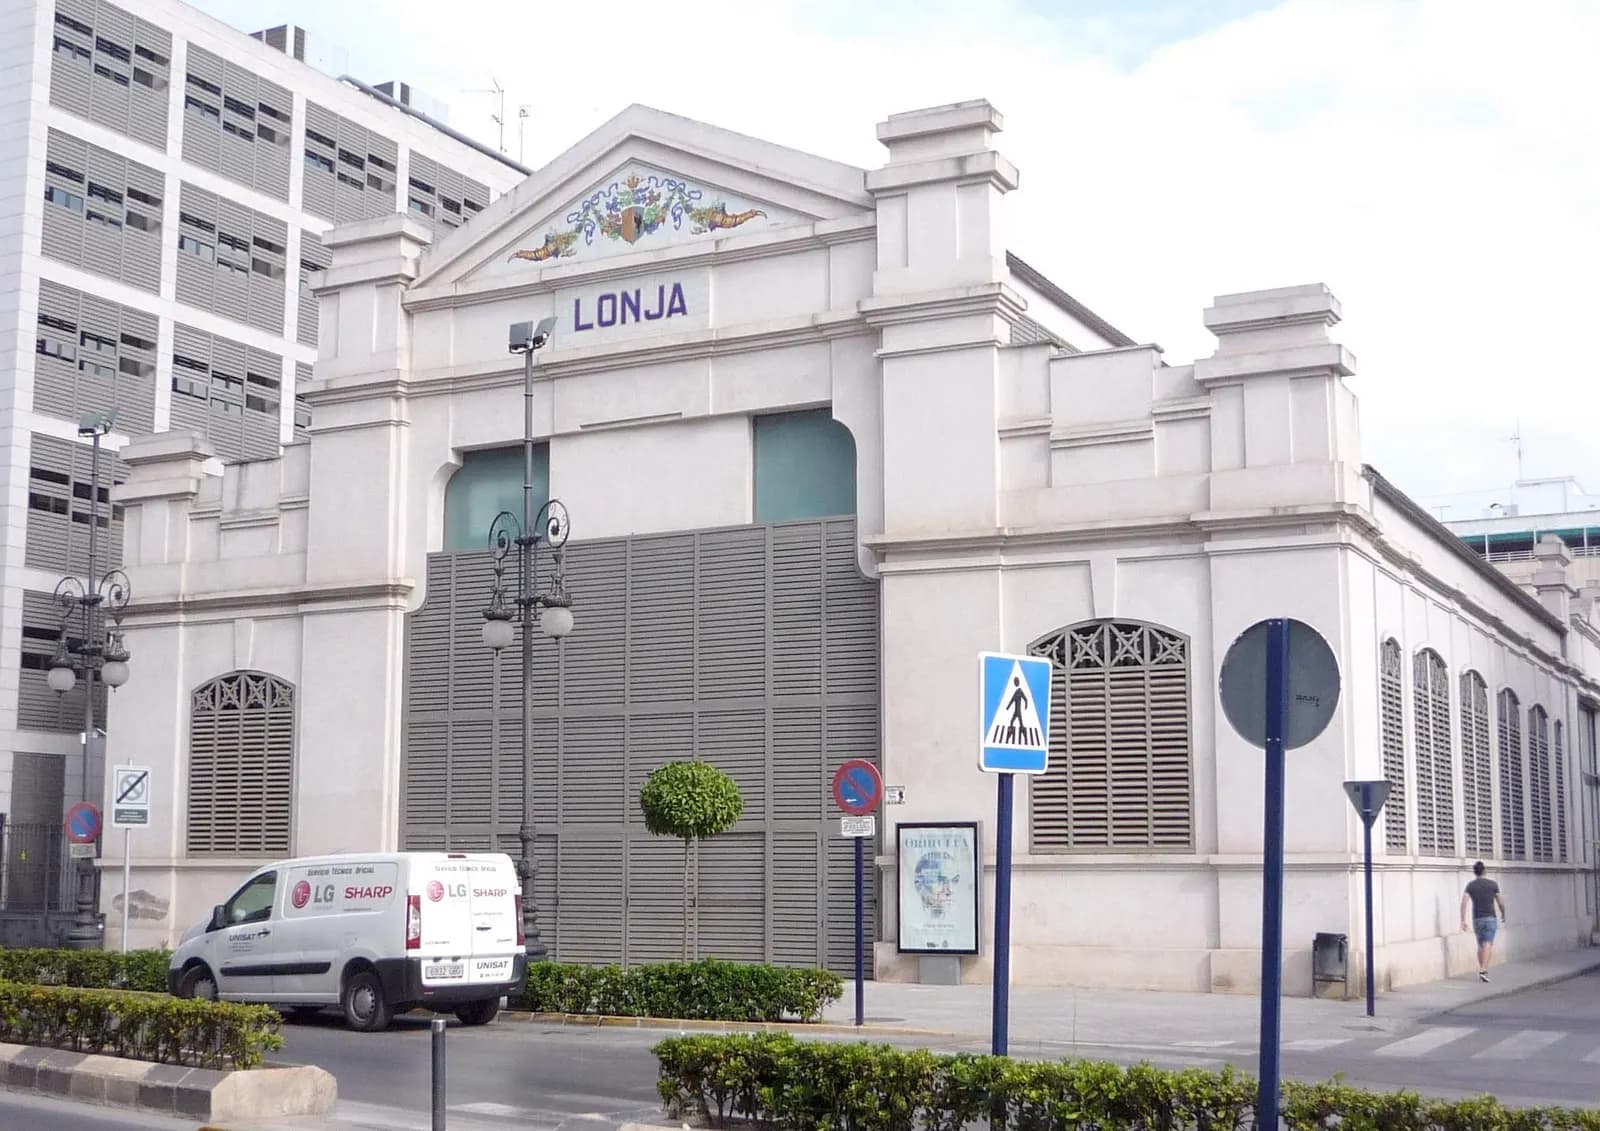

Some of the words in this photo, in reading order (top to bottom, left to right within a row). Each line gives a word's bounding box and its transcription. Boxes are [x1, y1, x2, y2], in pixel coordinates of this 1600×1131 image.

[574, 282, 688, 332] LONJA
[313, 884, 335, 903] LG
[344, 886, 393, 899] SHARP
[448, 884, 467, 898] LG
[473, 888, 507, 897] SHARP
[476, 960, 509, 970] UNISAT
